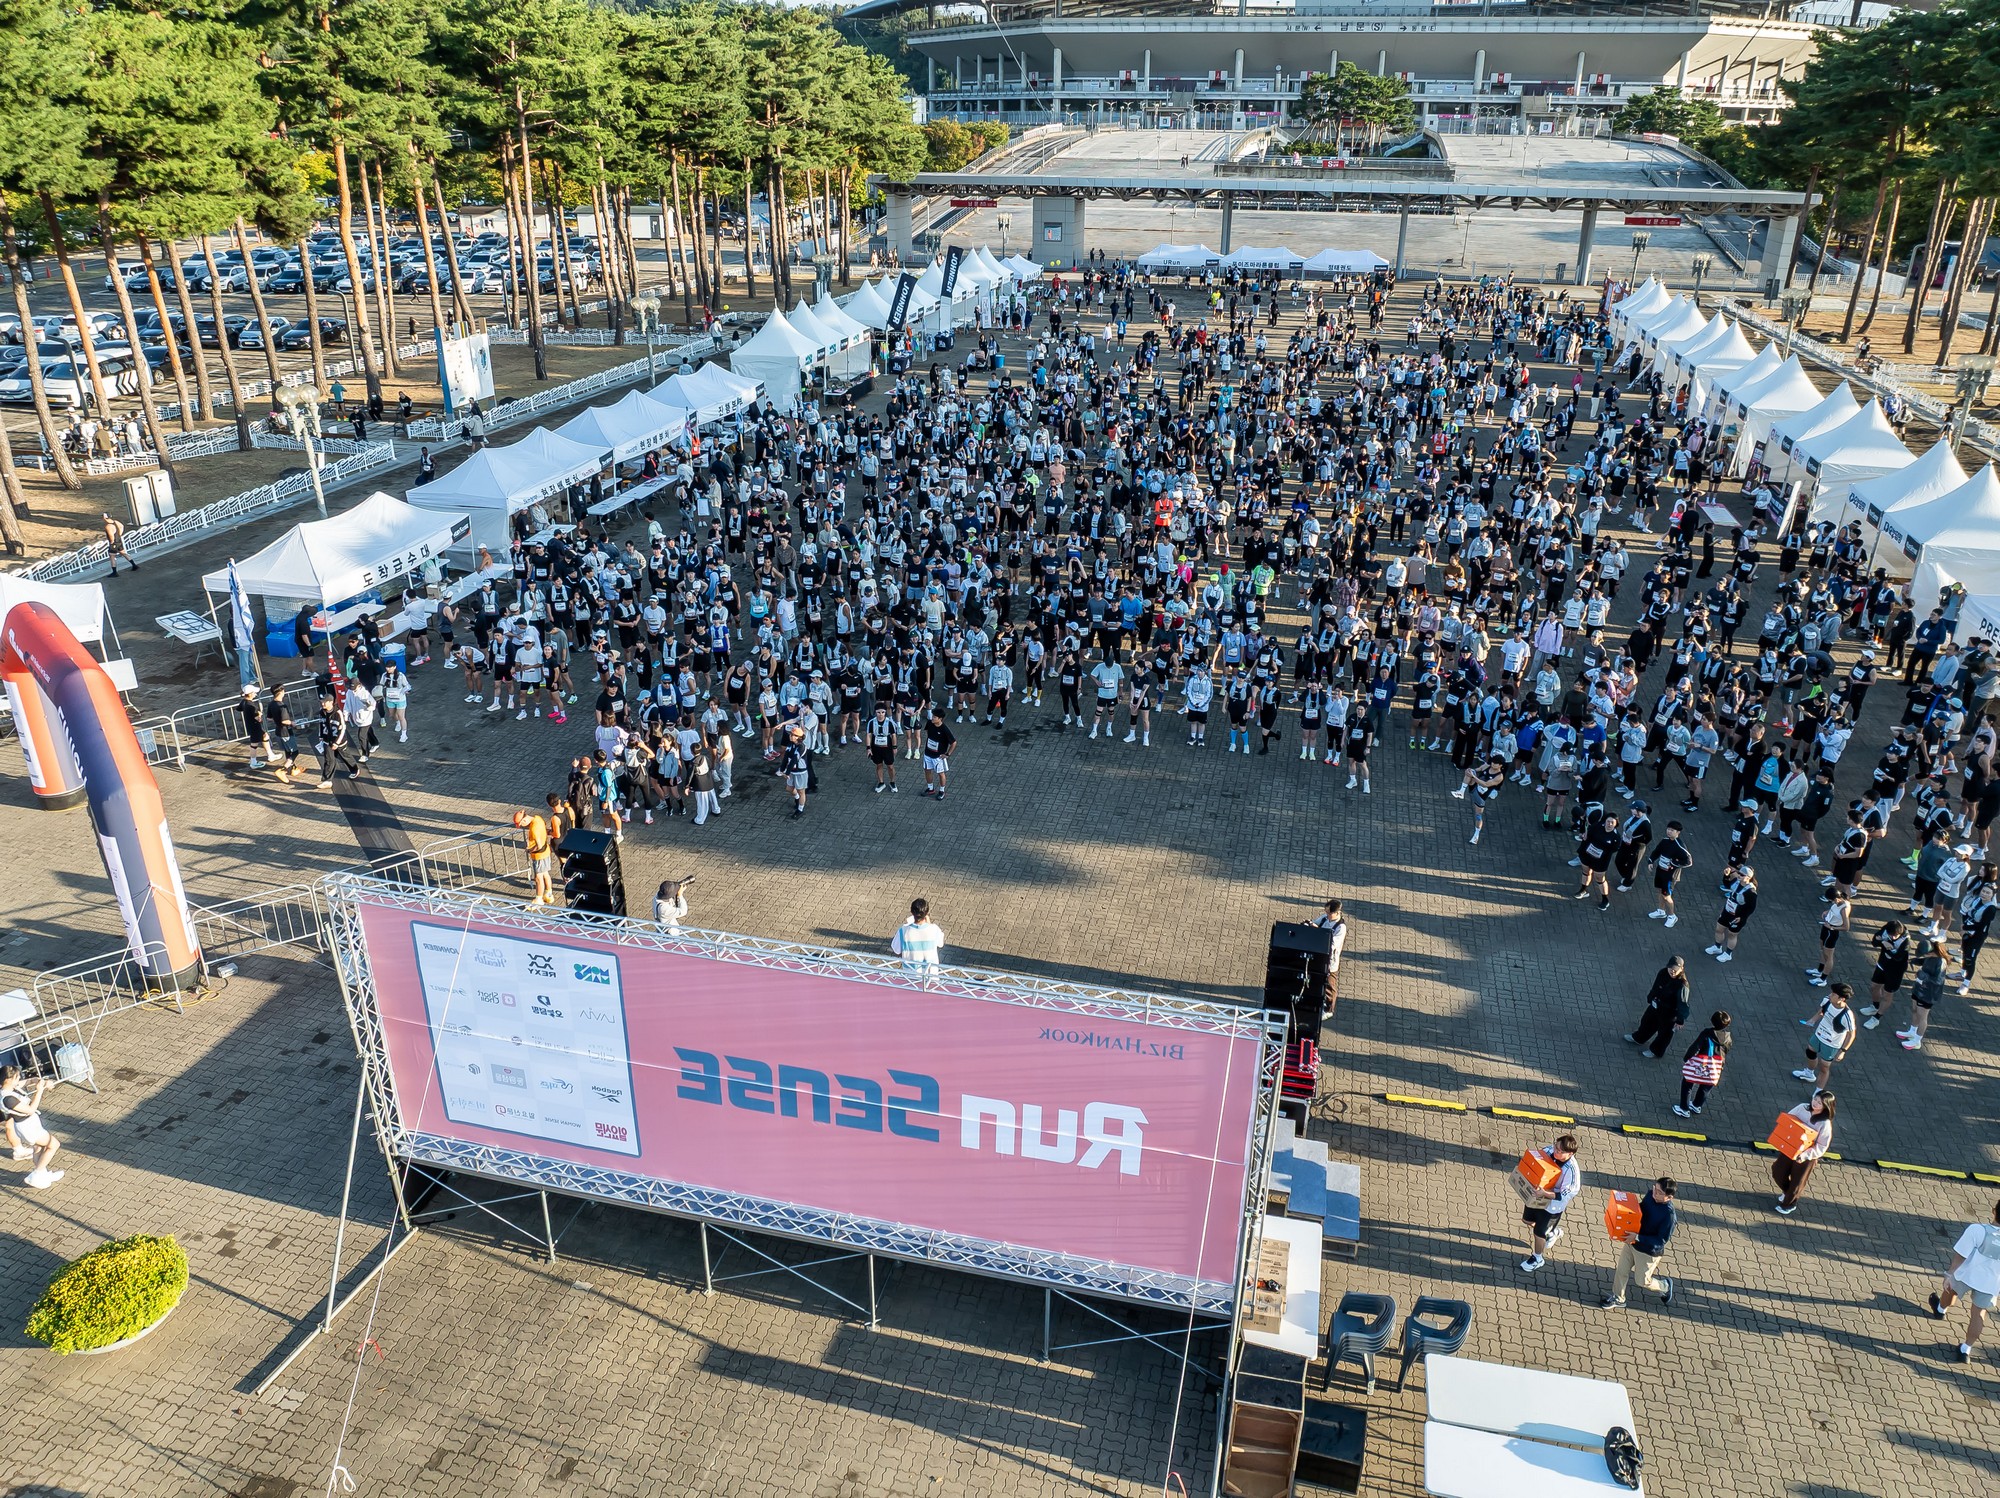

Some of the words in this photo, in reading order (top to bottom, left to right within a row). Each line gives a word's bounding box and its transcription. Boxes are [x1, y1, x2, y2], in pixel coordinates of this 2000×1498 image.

[946, 253, 958, 293] JOHNBER
[892, 281, 910, 325] JOHNBER
[363, 543, 430, 588] 도착급수대
[1979, 617, 2000, 646] PRE
